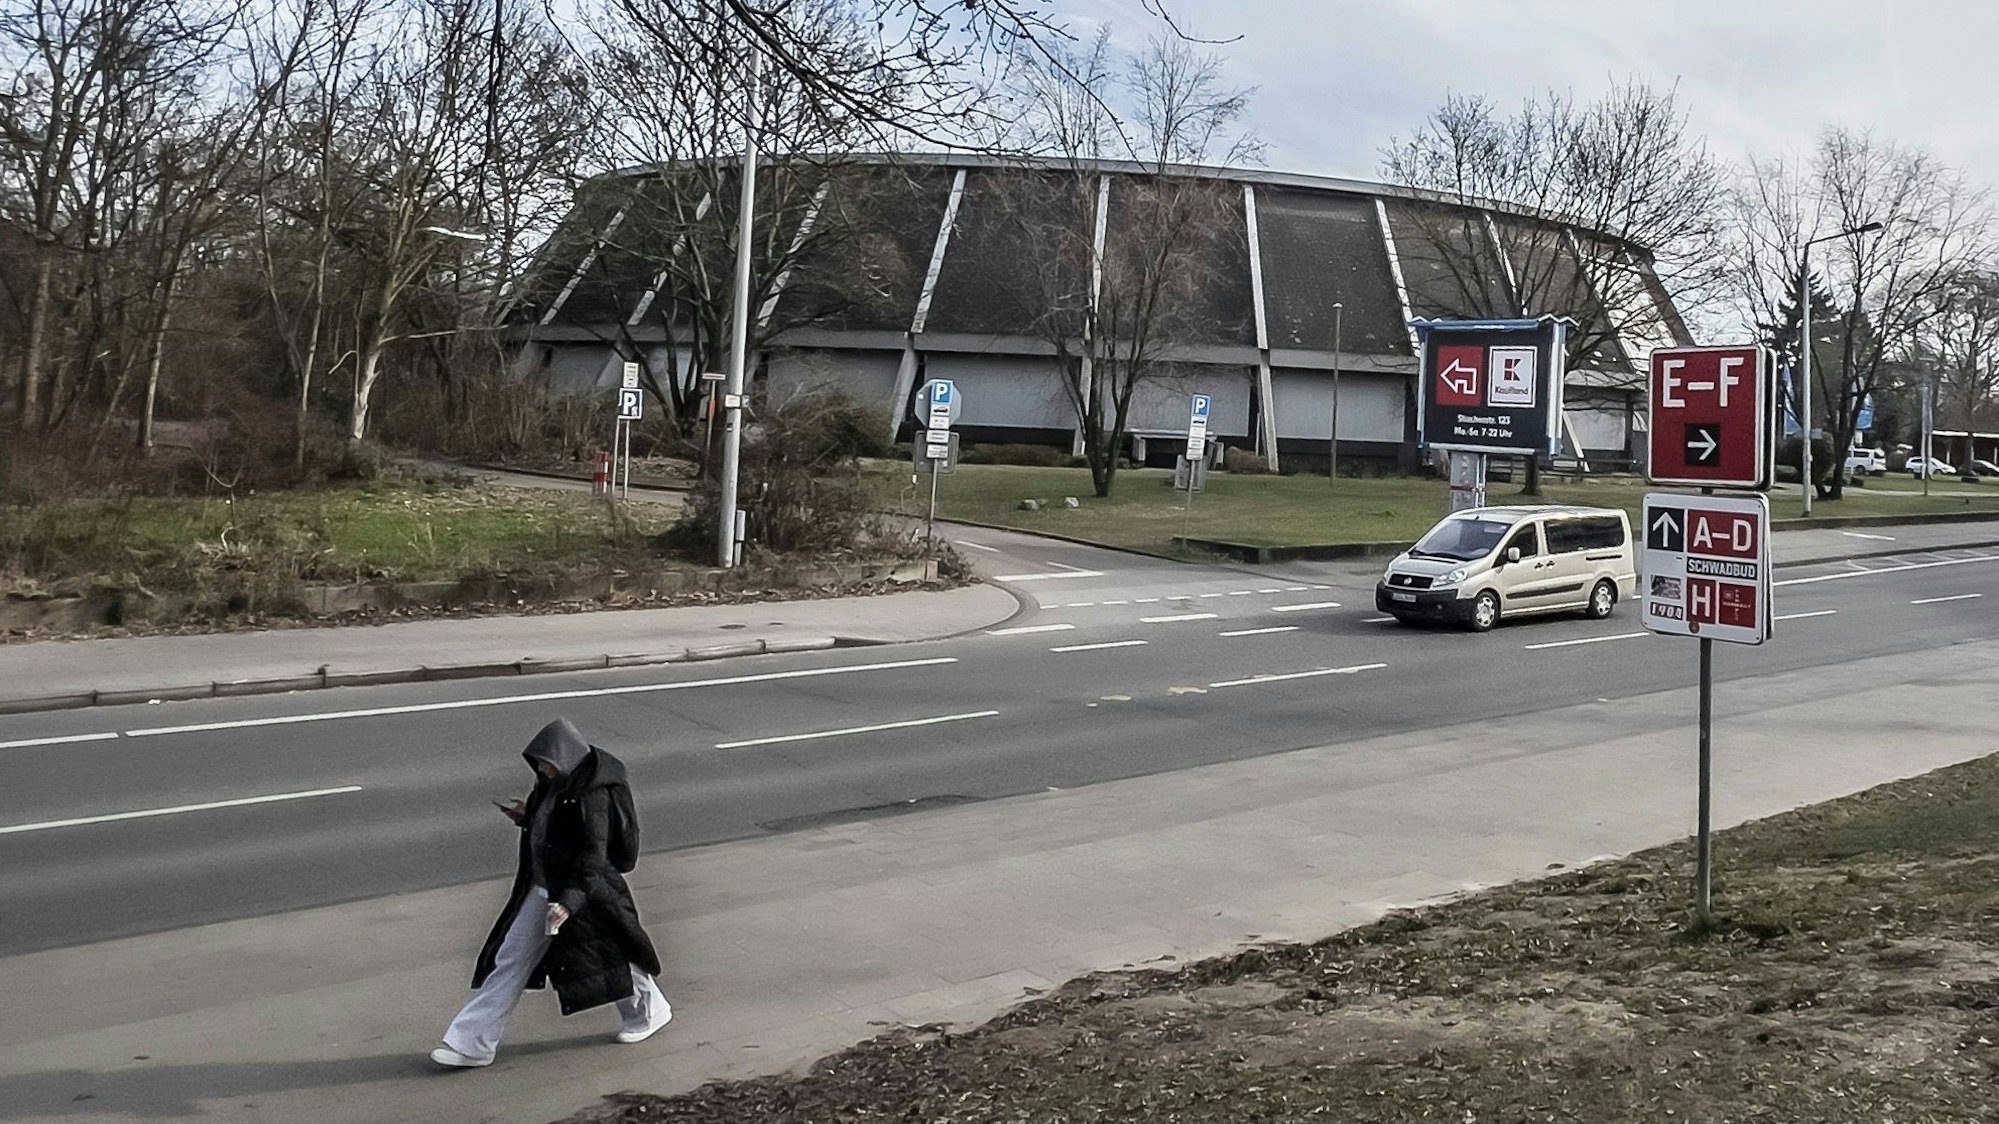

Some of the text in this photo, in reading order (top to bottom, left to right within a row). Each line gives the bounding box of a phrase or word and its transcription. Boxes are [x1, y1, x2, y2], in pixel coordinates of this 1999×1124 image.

[936, 383, 948, 401] P
[1663, 357, 1744, 407] E-F
[623, 392, 637, 415] P
[1195, 398, 1206, 413] P
[1693, 516, 1752, 551] A-D
[1688, 558, 1756, 578] SCHWADBUD
[1691, 584, 1710, 618] H
